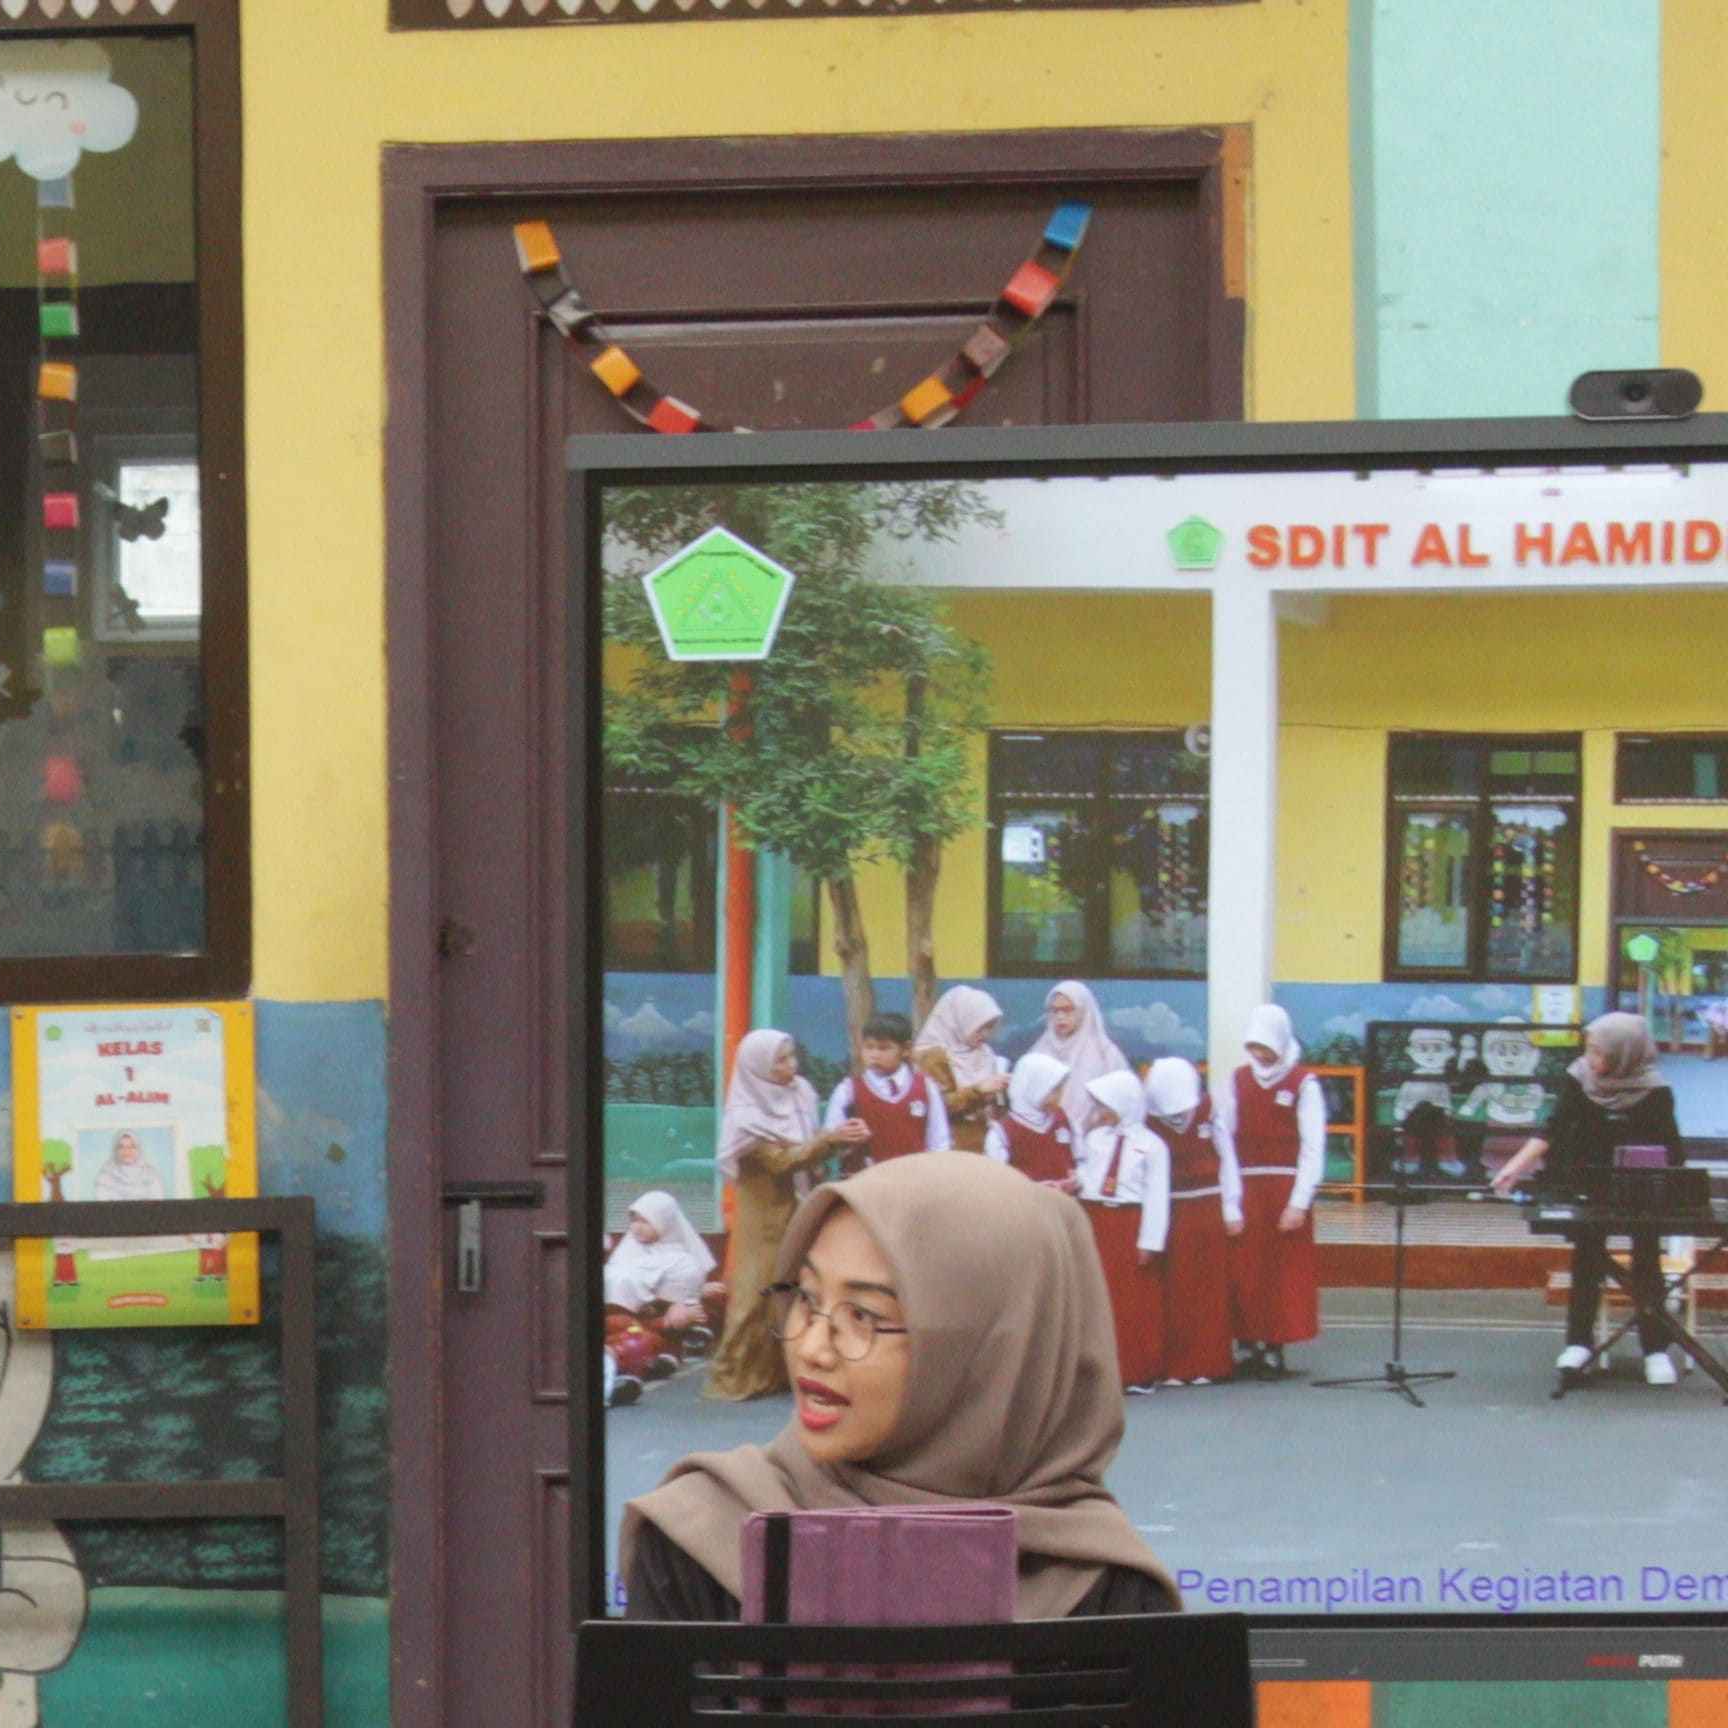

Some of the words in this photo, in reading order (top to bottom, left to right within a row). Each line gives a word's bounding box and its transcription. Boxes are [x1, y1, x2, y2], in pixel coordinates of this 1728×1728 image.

[1246, 523, 1390, 570] SDIT
[1410, 522, 1490, 568] AL
[97, 1040, 164, 1056] KELAS
[1177, 1568, 1423, 1614] Penampilan
[1439, 1567, 1624, 1613] Kegiatan
